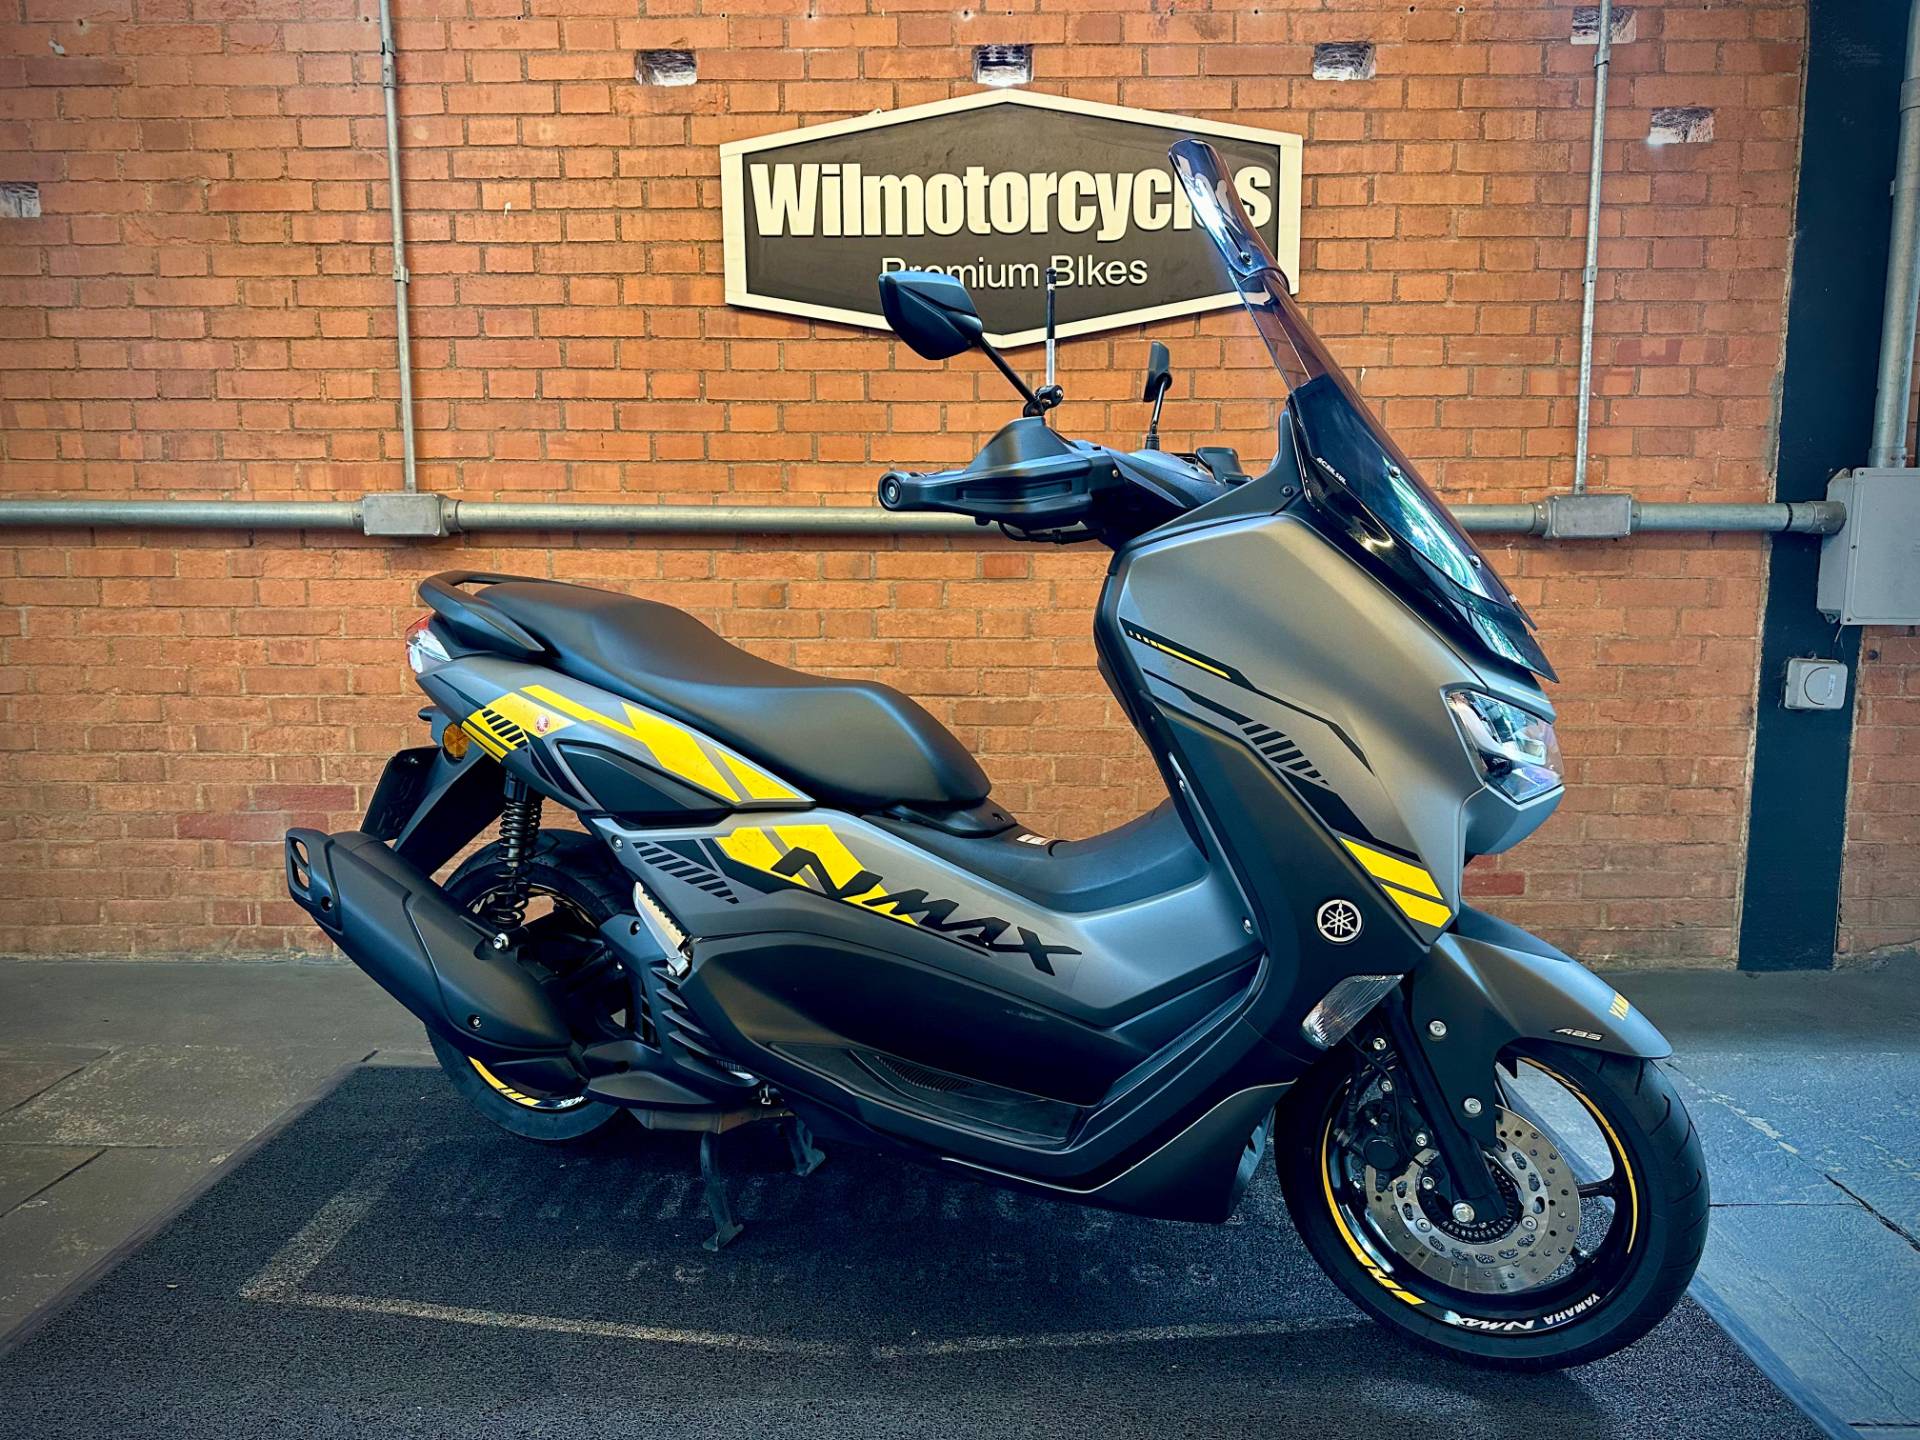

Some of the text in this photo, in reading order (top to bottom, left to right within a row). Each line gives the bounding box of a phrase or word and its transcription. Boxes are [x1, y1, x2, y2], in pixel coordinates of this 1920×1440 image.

[881, 256, 1039, 289] Pmium
[771, 846, 1082, 976] NMAX
[1555, 1028, 1602, 1041] ABS
[1543, 1293, 1601, 1325] YAMAHA
